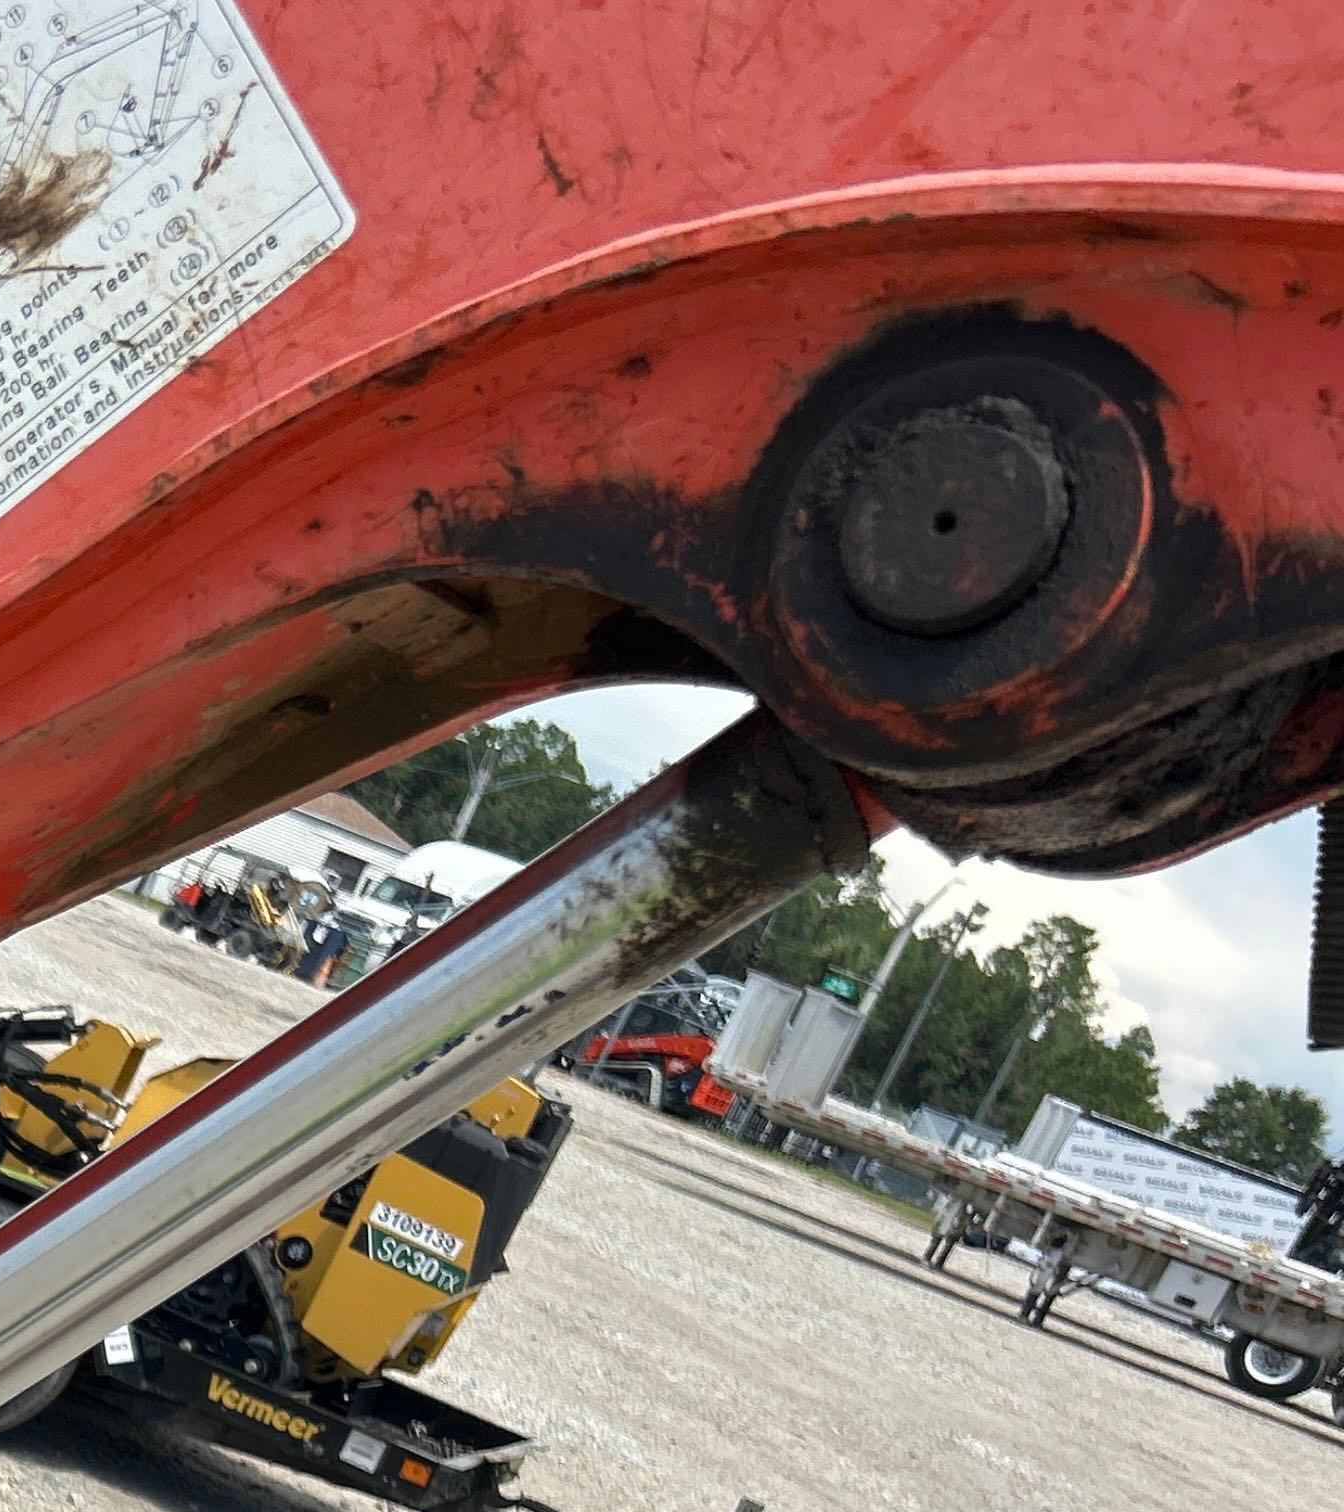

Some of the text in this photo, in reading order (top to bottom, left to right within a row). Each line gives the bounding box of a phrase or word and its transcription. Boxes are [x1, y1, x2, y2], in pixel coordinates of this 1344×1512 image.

[12, 305, 85, 369] Bearing
[90, 252, 150, 300] Teeth
[20, 264, 78, 319] points
[110, 310, 180, 374] Manual
[187, 276, 218, 312] for
[227, 235, 278, 281] more
[31, 362, 68, 401] Ball
[74, 300, 148, 365] Bearing
[0, 371, 32, 404] 200
[83, 386, 118, 425] and
[378, 1204, 456, 1254] 3109139
[208, 1372, 320, 1442] Vermeer
